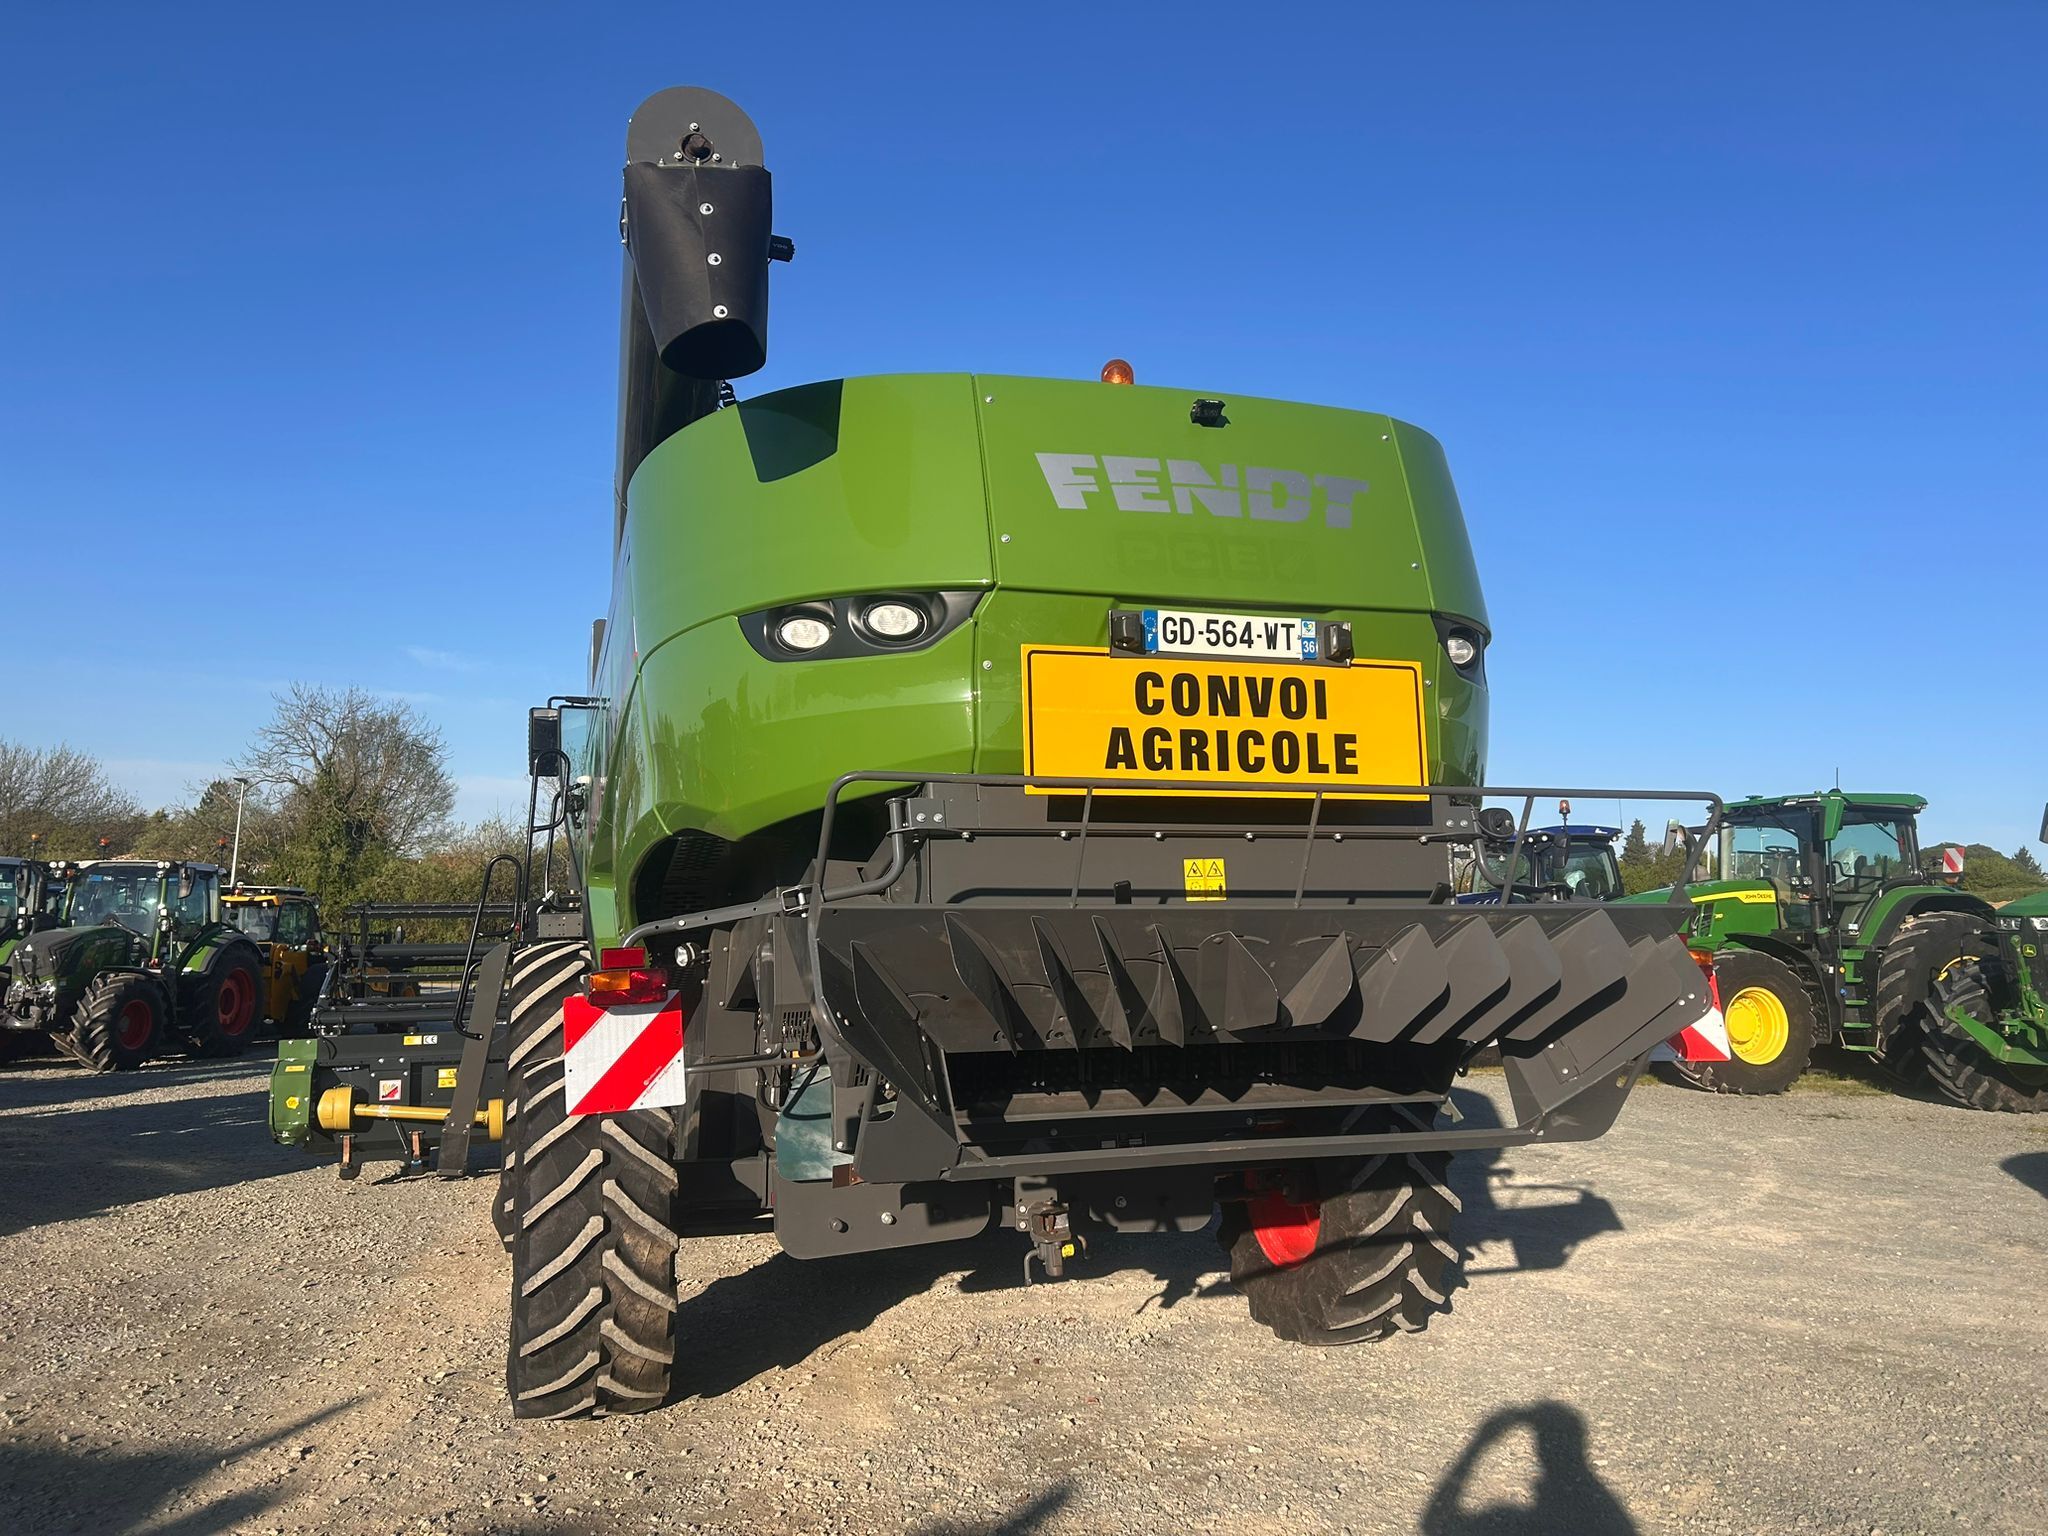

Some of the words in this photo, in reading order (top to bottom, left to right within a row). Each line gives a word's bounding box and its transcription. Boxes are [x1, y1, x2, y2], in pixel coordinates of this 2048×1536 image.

[1034, 452, 1369, 528] FENDT
[1147, 633, 1154, 642] F
[1162, 616, 1296, 651] GD-564-WT
[1302, 640, 1316, 654] 36
[1134, 671, 1328, 720] CONVOI
[1104, 726, 1359, 775] AGRICOLE
